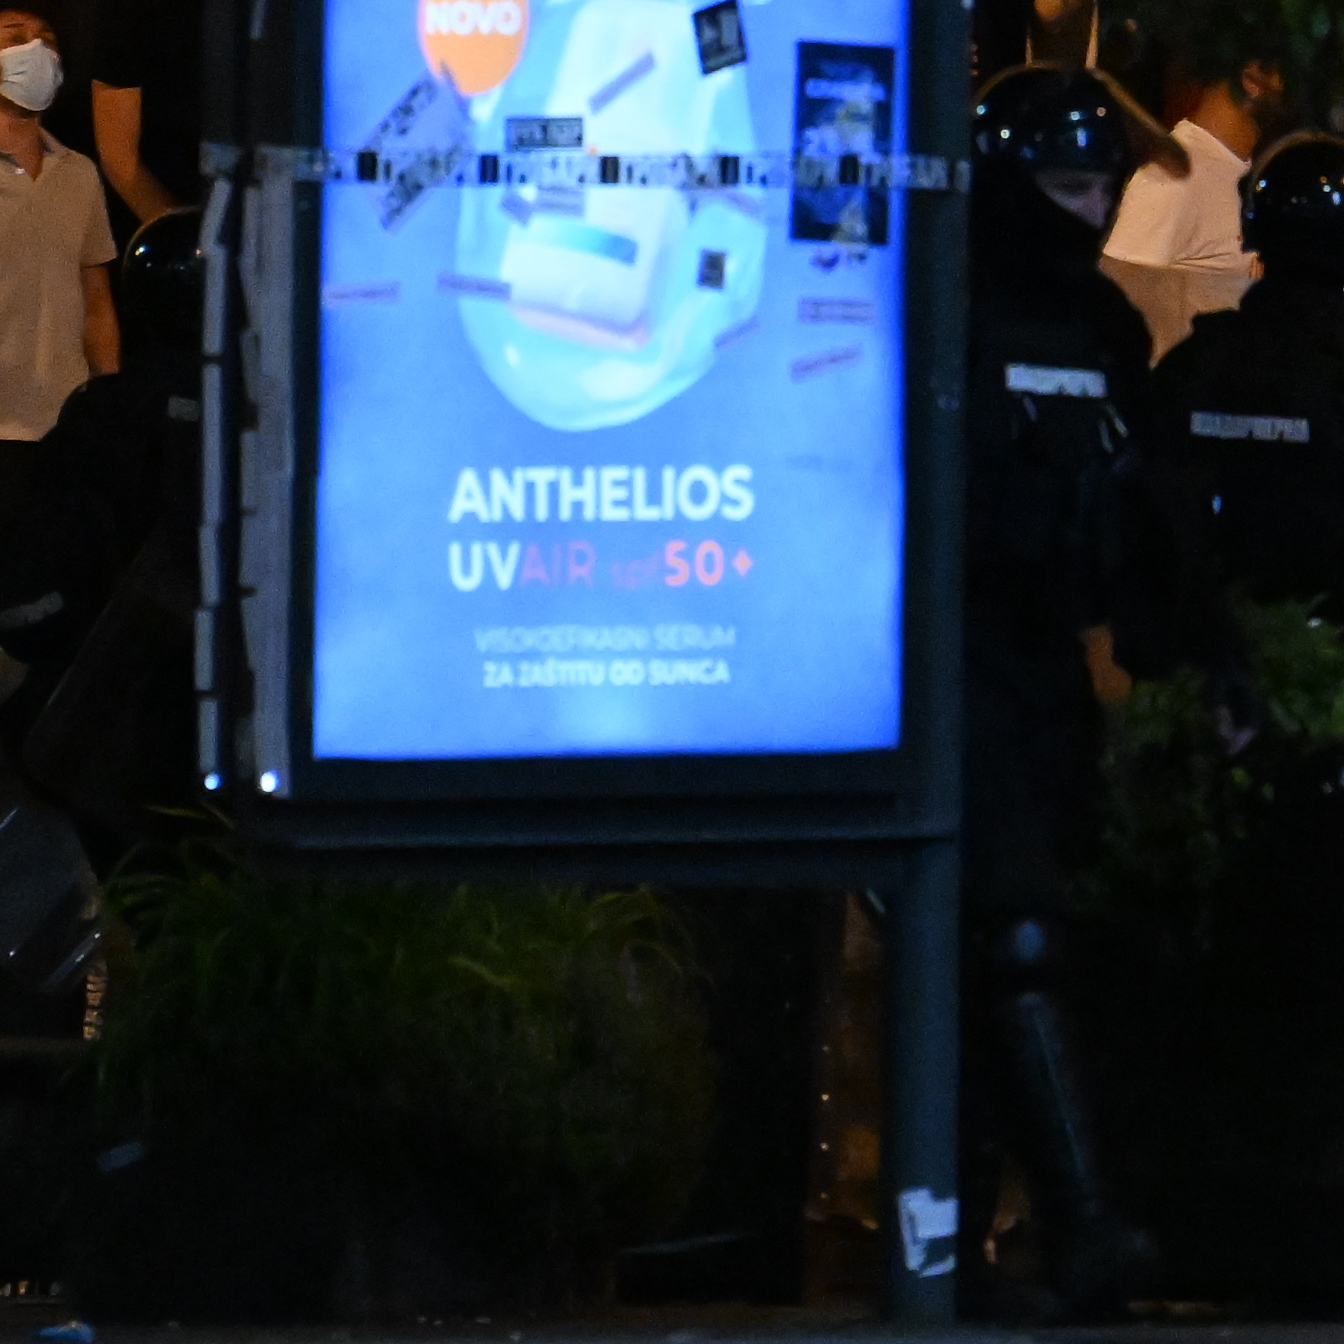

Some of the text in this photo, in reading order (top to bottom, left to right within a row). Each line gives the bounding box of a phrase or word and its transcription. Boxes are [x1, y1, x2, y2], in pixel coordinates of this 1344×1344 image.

[425, 0, 521, 35] NOVO
[448, 465, 754, 523] ANTHELIOS
[664, 539, 753, 586] 50+
[482, 660, 513, 688] ZA
[609, 659, 646, 686] OD
[648, 658, 732, 686] SUNCA
